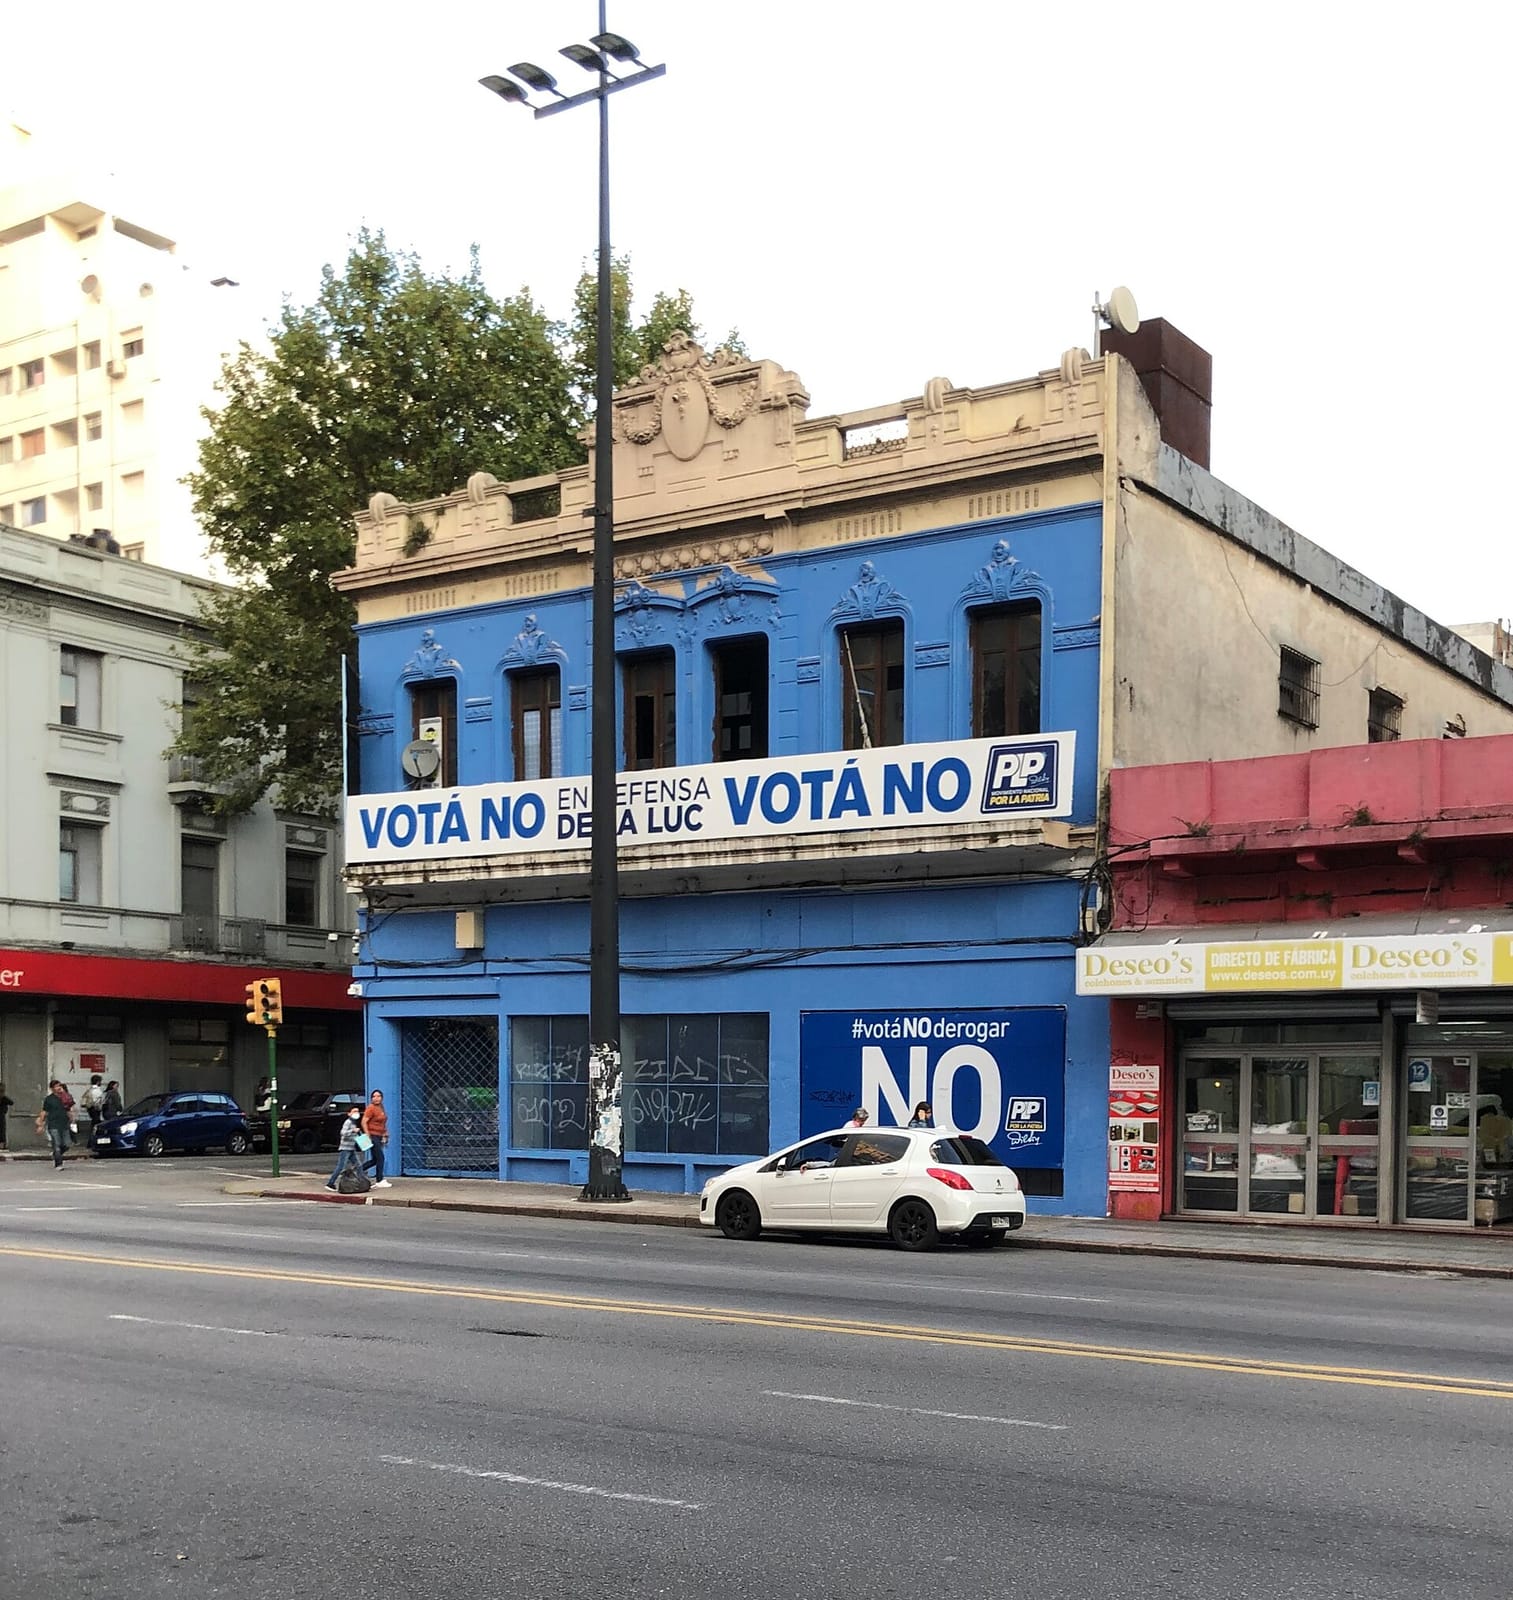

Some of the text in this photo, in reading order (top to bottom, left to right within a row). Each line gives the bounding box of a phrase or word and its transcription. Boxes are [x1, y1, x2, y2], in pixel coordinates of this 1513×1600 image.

[558, 777, 711, 810] EN EFENSA
[723, 757, 971, 826] VOTÁ NO
[990, 793, 1050, 805] POR LA PATRIA
[359, 792, 546, 849] VOTÁ NO
[557, 803, 703, 840] DE A LUC
[1084, 951, 1193, 977] Deseo's
[1211, 946, 1336, 968] DIRECTO DE FÁBRICA
[1351, 941, 1479, 969] Deseo's
[1211, 969, 1336, 982] www.deseos.com.uy
[861, 1043, 1002, 1147] NO
